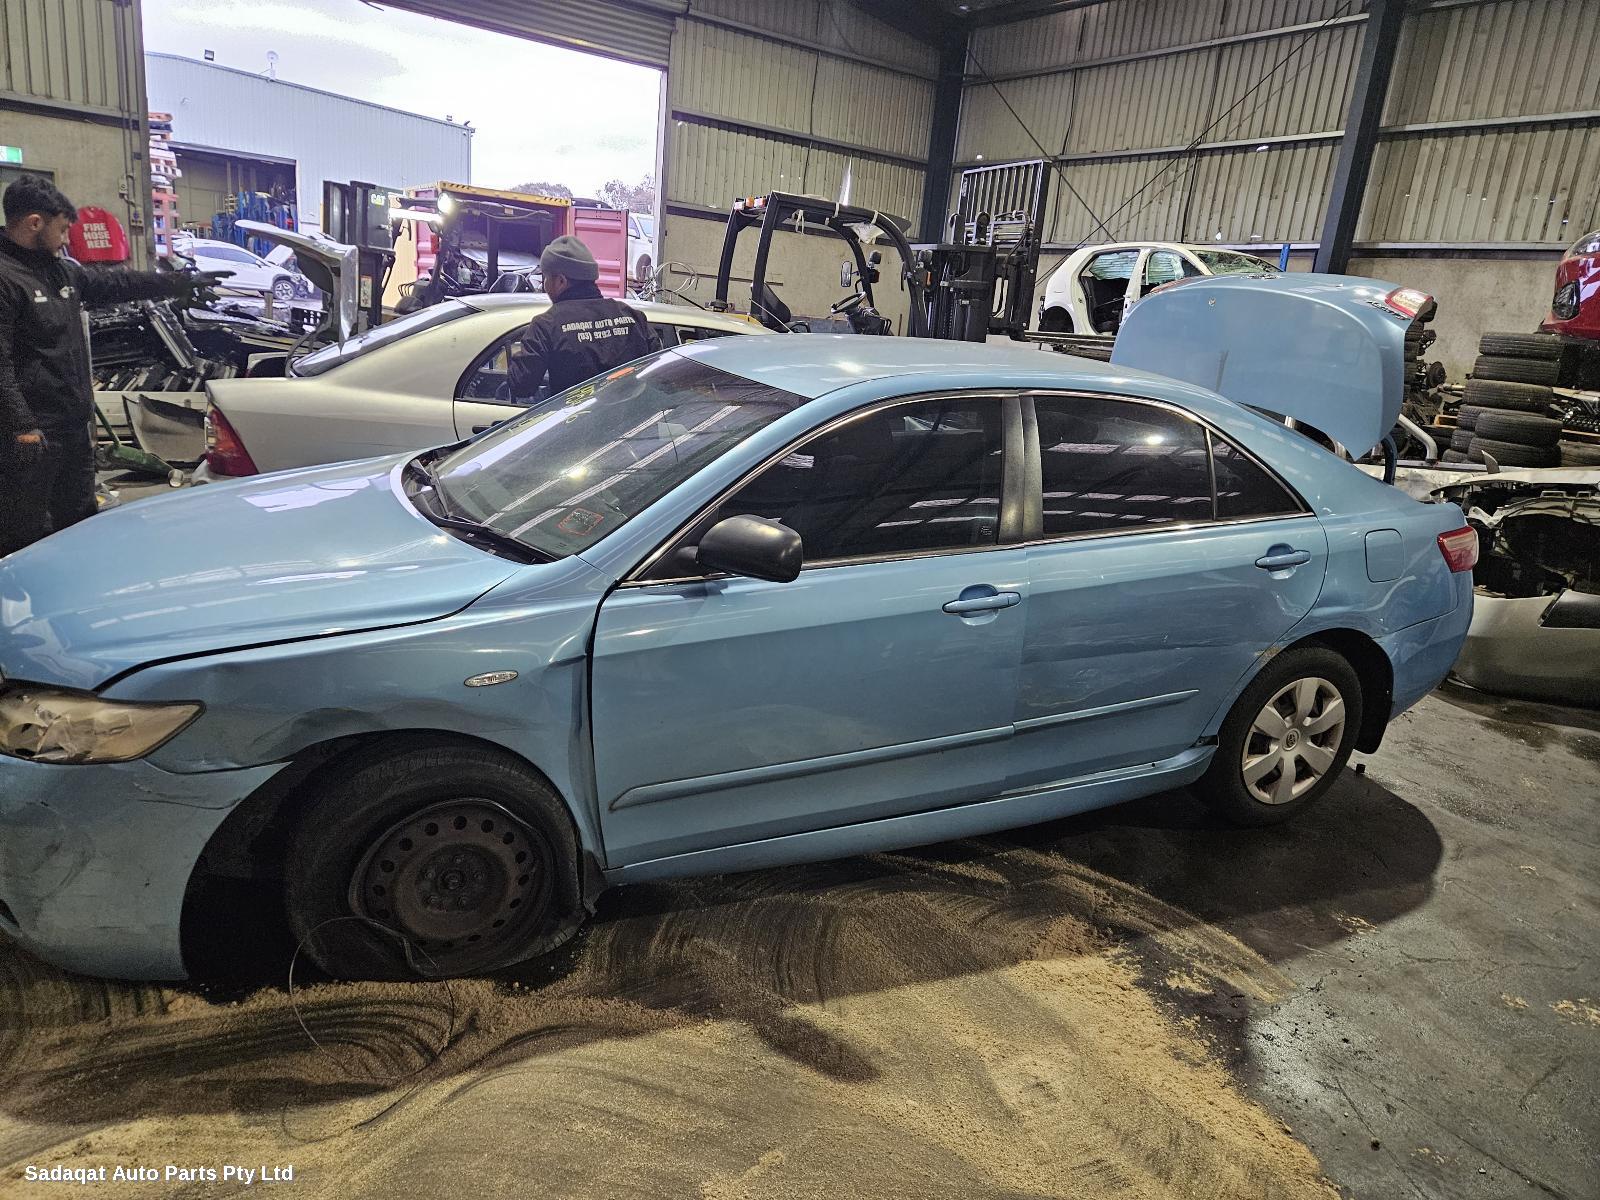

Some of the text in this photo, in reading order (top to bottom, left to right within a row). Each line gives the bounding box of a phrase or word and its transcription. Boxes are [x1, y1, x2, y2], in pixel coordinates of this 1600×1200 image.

[371, 193, 385, 206] CAT
[83, 223, 106, 231] FIRE
[83, 231, 110, 240] HOSE
[87, 240, 112, 248] REEL
[562, 316, 635, 333] SADAQAT AUTO PARTS
[578, 332, 592, 342] (03)
[594, 330, 611, 339] 9792
